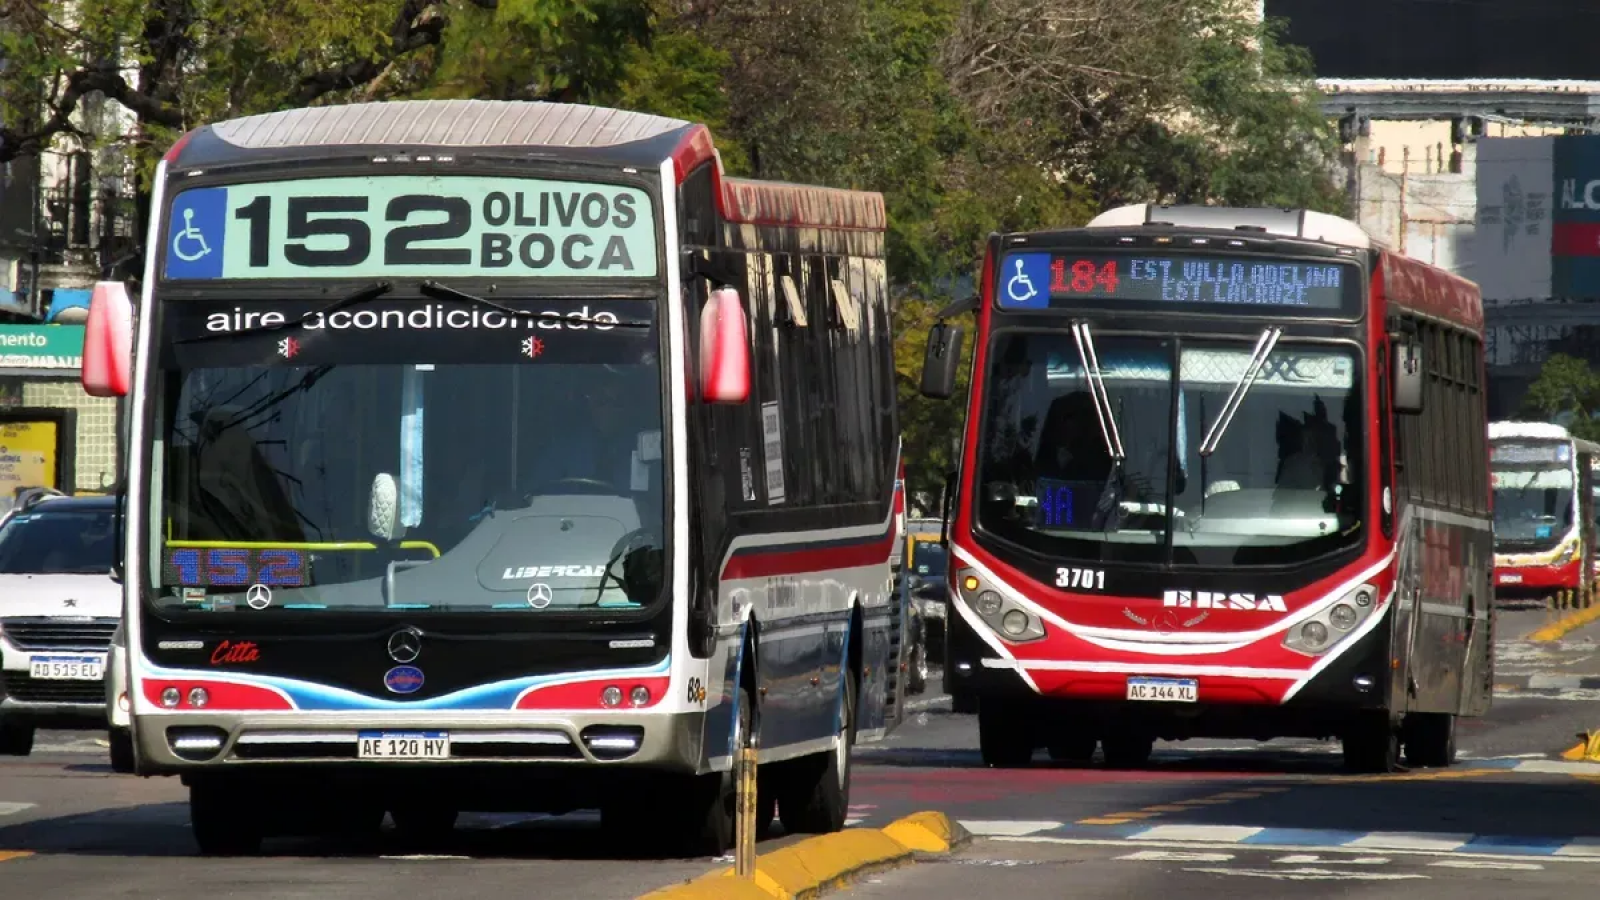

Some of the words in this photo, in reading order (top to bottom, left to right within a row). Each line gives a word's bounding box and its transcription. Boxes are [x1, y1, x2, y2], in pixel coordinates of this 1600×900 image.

[482, 191, 637, 228] OLIVOS
[235, 195, 472, 267] 152
[480, 232, 635, 271] BOCA
[1049, 257, 1120, 294] 184
[1183, 261, 1245, 286] VILLA
[1213, 281, 1310, 305] LACROZE
[206, 307, 286, 332] aire
[302, 305, 619, 331] acondicionado
[171, 548, 305, 586] 152
[1056, 567, 1105, 590] 3701
[1163, 590, 1288, 612] ERSA
[211, 639, 261, 665] Citta
[34, 663, 49, 677] AD
[81, 663, 98, 677] EL
[1131, 684, 1146, 698] AC
[1178, 687, 1194, 700] XL
[363, 739, 382, 756] AE
[388, 739, 419, 757] 120
[424, 739, 444, 757] HY
